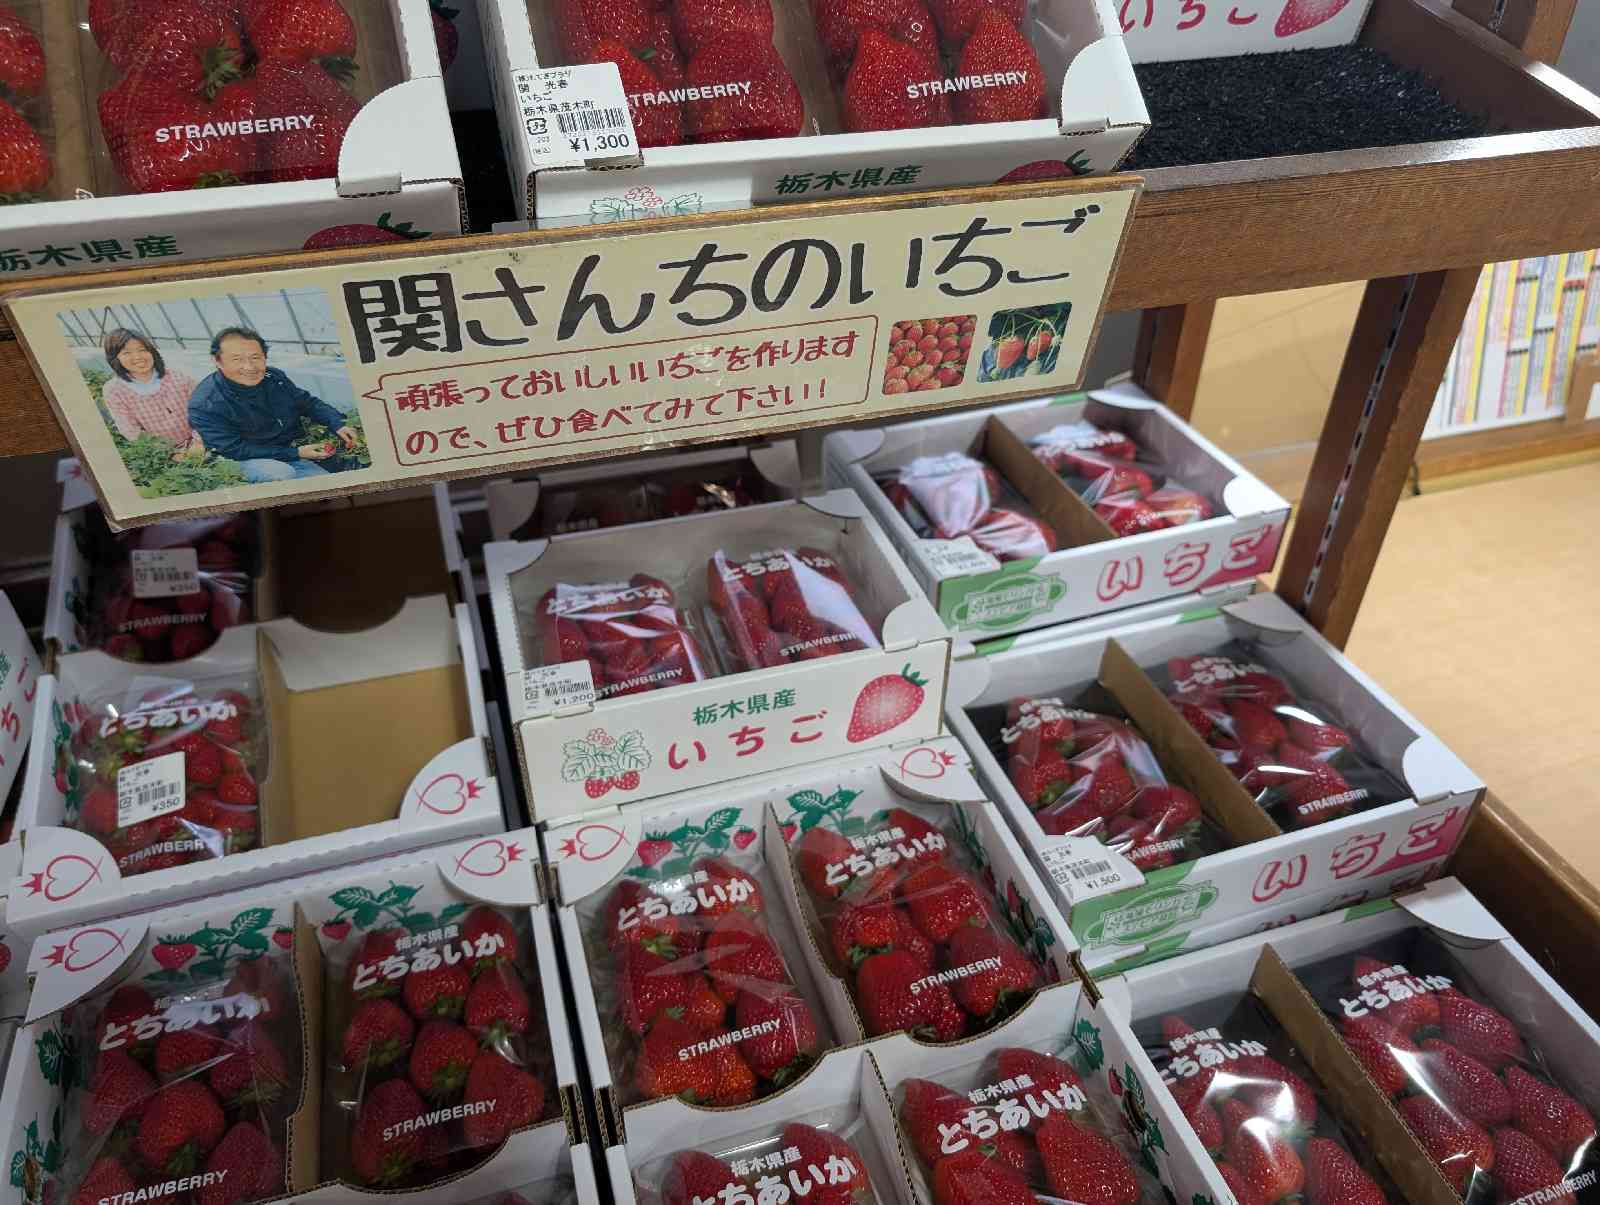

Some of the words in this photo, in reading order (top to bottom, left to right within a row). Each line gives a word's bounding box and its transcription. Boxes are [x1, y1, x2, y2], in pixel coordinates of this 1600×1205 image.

[520, 91, 553, 104] いちご
[906, 70, 1029, 99] STRAWBERRY
[156, 114, 315, 143] STRAWBERRY
[775, 165, 924, 195] 栃木県産
[340, 203, 1101, 363] 関さんちのいちご
[1096, 525, 1272, 602] いちご
[779, 631, 857, 657] STRAWBERR
[692, 690, 796, 725] 栃木県産
[668, 711, 828, 769] いちご
[119, 838, 206, 868] STRAWBERR
[824, 832, 947, 886] とちあいか
[1251, 806, 1459, 902] いちご
[617, 878, 755, 931] とちあいか
[352, 932, 505, 991] とちあいか
[909, 957, 1003, 995] STRAWBERRY
[1339, 974, 1453, 1017] とちあいか
[677, 1018, 781, 1062] STRAWBERRY
[967, 1073, 1033, 1105] 栃木県産
[382, 1099, 498, 1142] STRAWBERRY
[936, 1083, 1087, 1154] とちあいか
[693, 1154, 857, 1205] ちあいか
[730, 1146, 802, 1177] 栃木県産
[98, 1169, 228, 1205] STRAWBERRY
